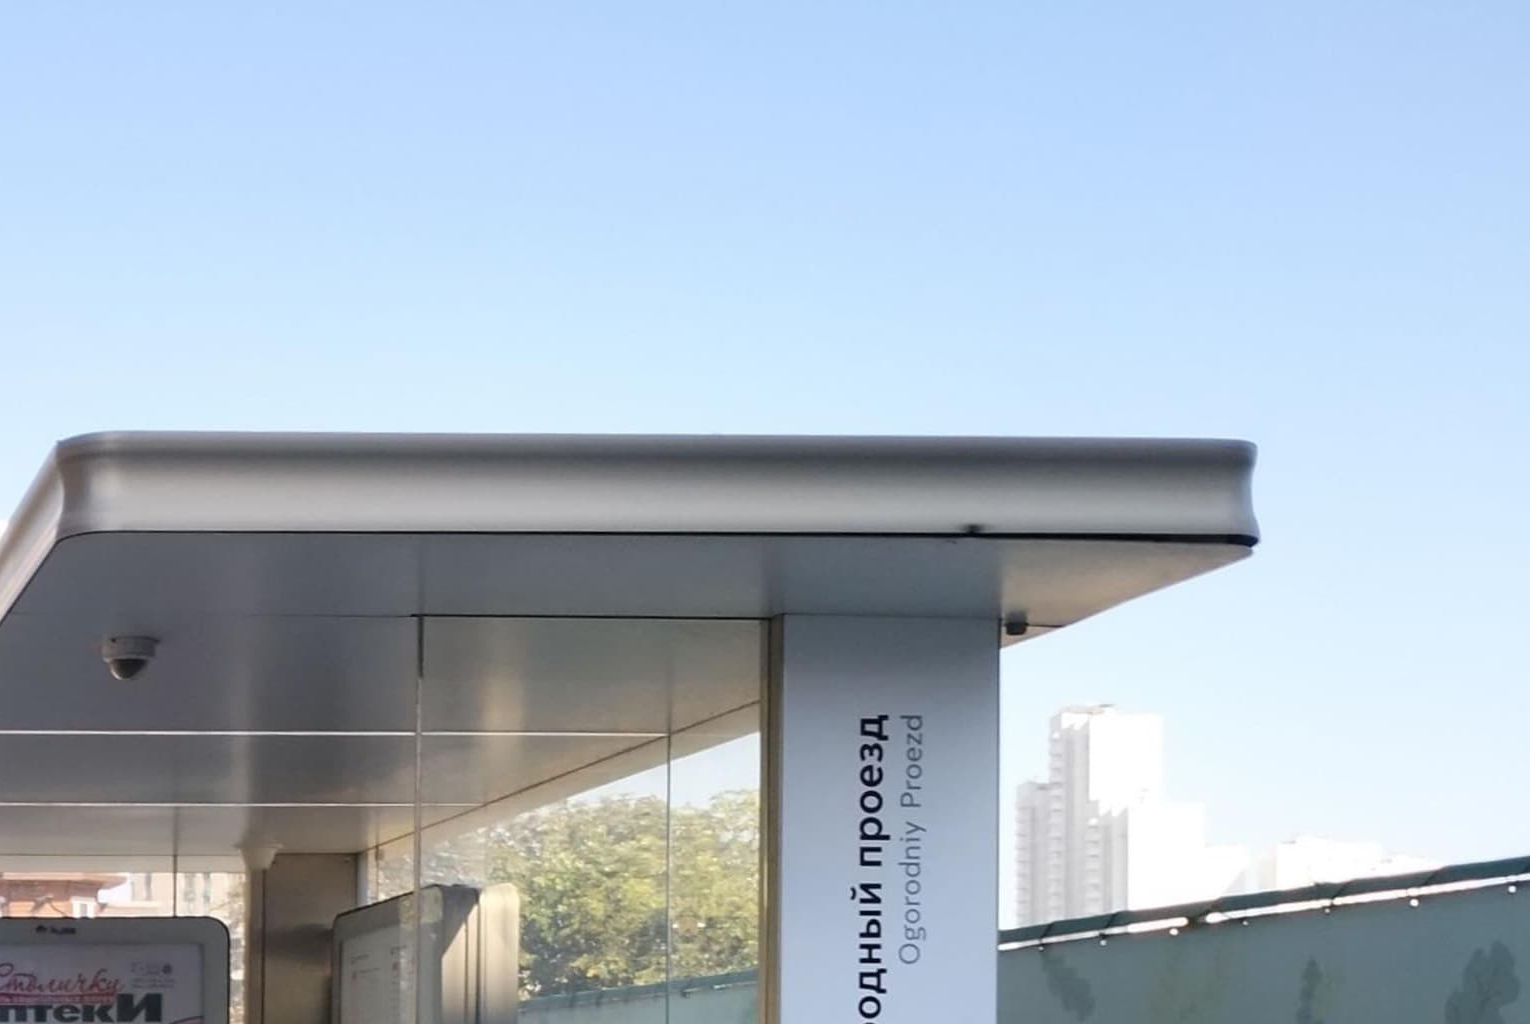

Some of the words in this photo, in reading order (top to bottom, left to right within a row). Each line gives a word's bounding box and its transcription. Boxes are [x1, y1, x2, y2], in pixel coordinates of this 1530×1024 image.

[858, 714, 890, 867] проезд
[900, 714, 924, 808] Proezd
[898, 821, 927, 965] Ogorodniy
